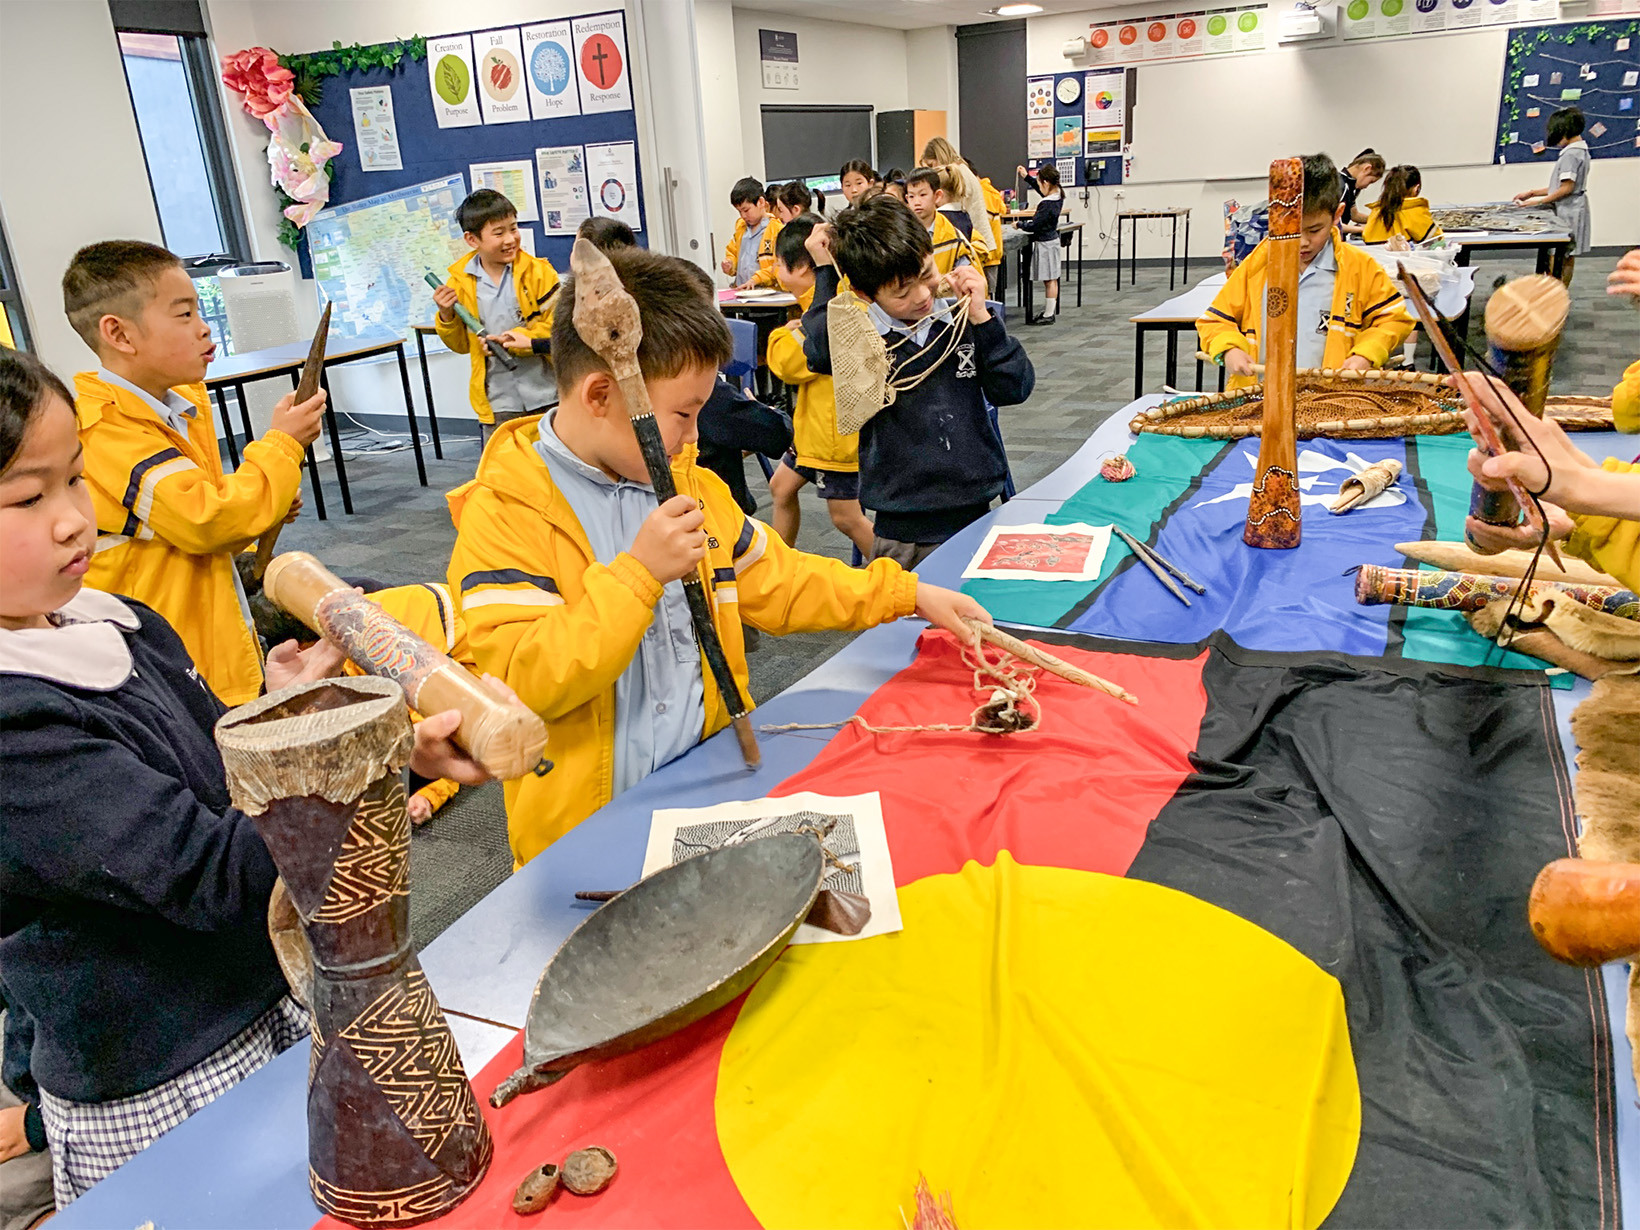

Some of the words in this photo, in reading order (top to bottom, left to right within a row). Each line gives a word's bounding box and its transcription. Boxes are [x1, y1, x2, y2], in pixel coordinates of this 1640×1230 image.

[575, 19, 621, 34] Redemption
[526, 27, 567, 41] Restoration
[490, 35, 503, 46] Fall
[434, 42, 463, 53] Creation
[545, 97, 563, 108] Hope
[589, 91, 621, 103] Response
[445, 106, 468, 117] Purpose
[492, 103, 518, 113] Problem
